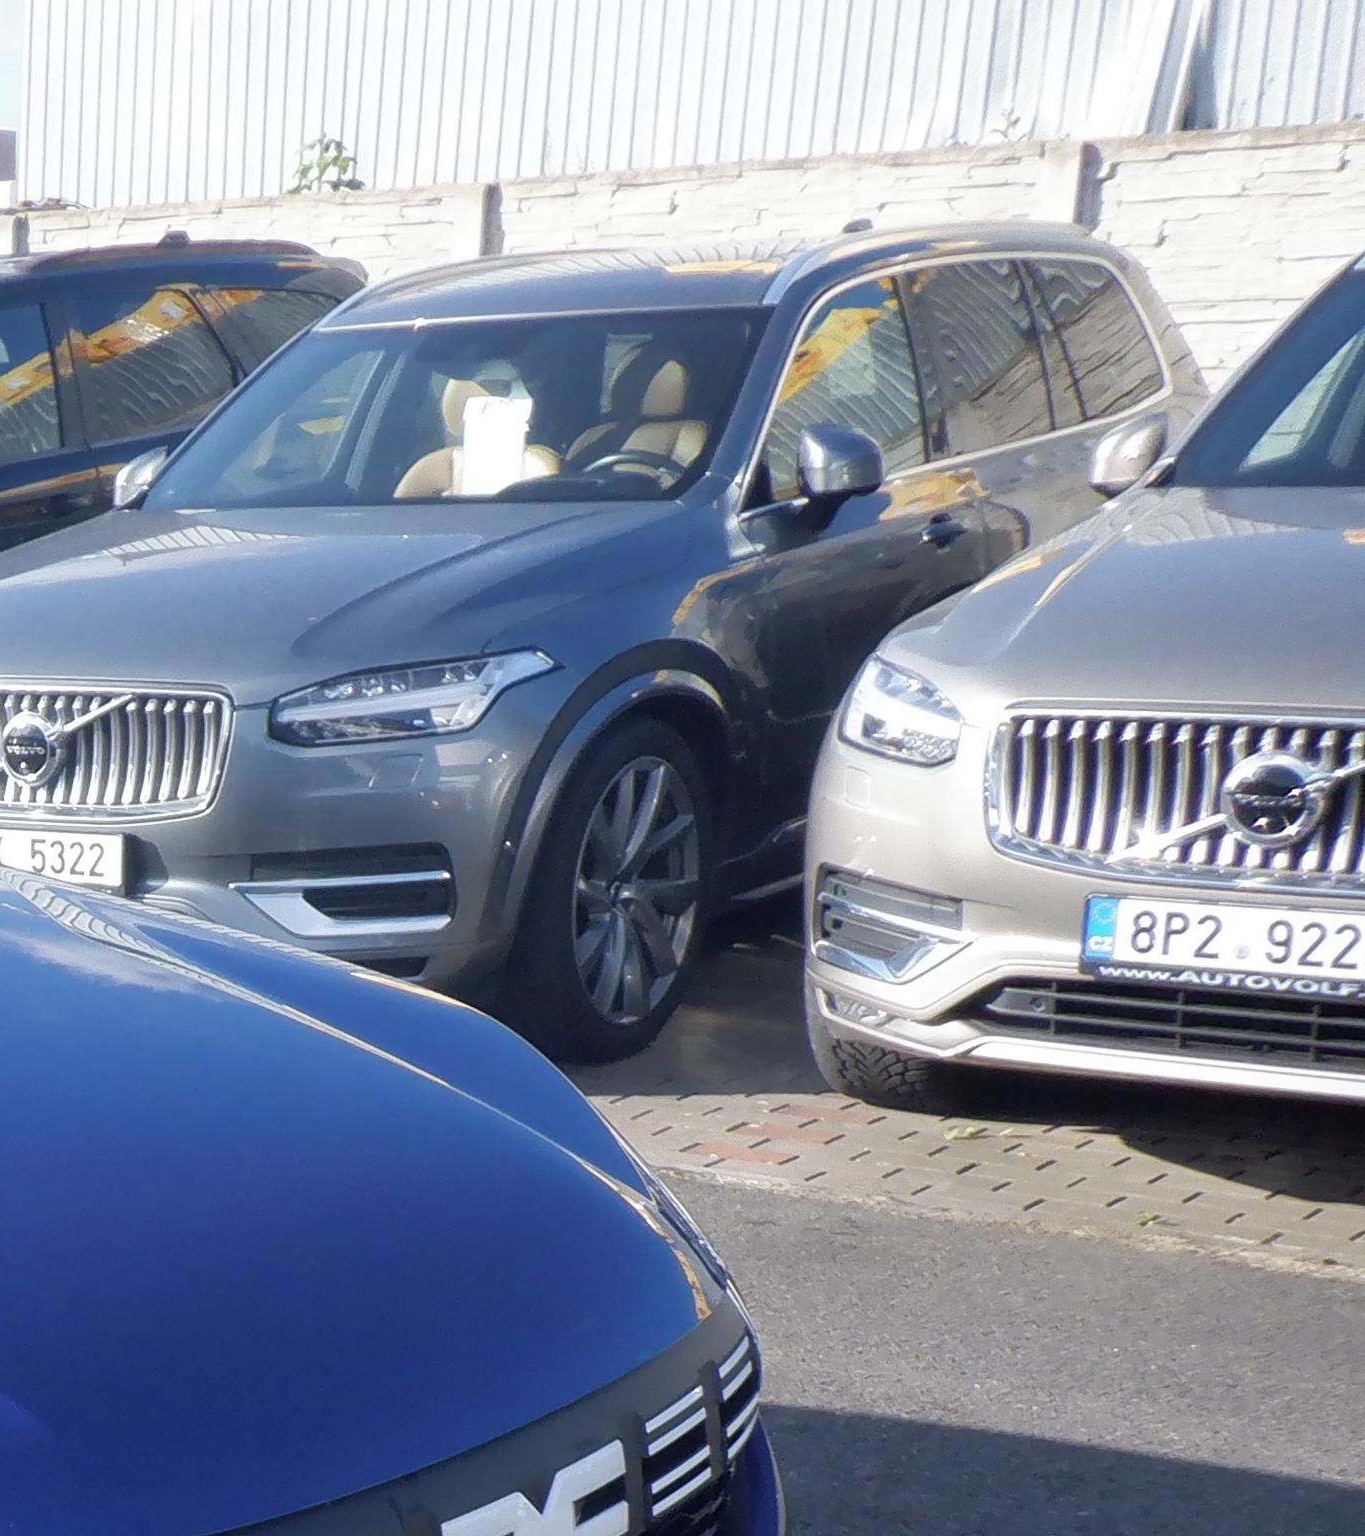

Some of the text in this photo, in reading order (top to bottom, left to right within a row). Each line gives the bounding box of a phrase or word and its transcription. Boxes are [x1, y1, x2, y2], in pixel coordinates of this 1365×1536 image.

[6, 745, 46, 755] VOLVO
[30, 838, 105, 878] 5322
[1088, 935, 1114, 952] CZ
[1130, 910, 1223, 960] 8P2
